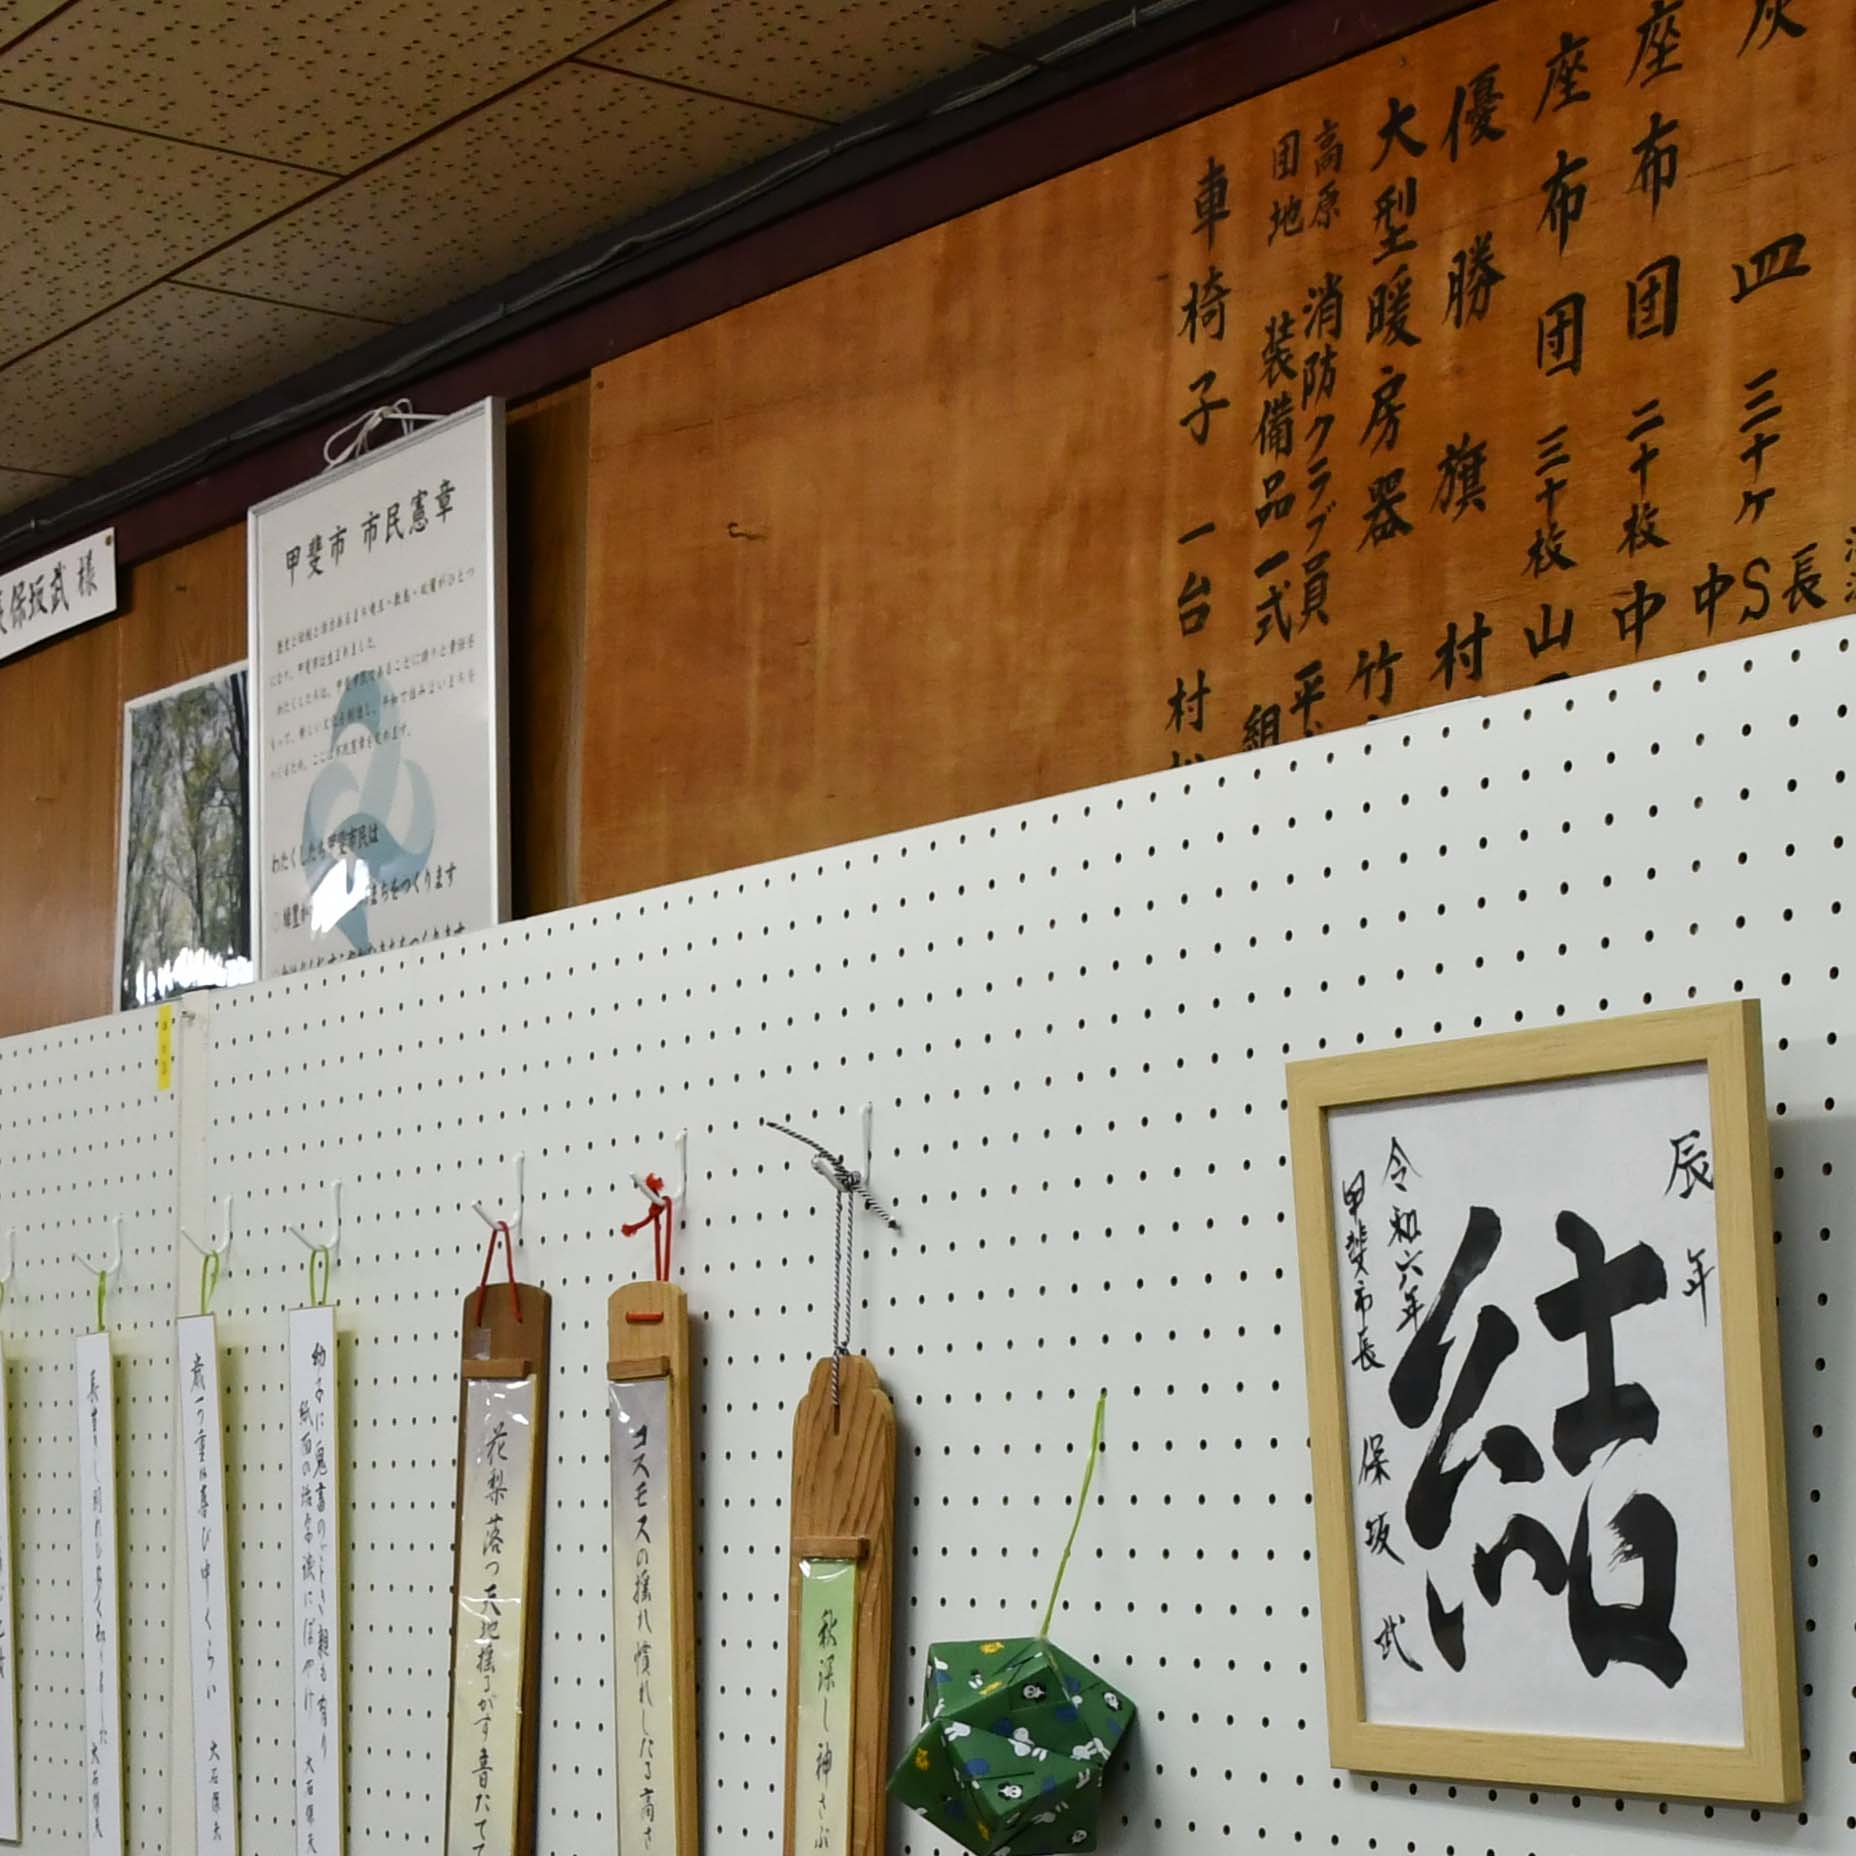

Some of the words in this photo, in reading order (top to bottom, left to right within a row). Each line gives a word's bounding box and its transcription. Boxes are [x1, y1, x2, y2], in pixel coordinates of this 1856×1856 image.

[1309, 119, 1344, 231] 高原
[1534, 32, 1592, 376] 座布団
[1624, 0, 1685, 341] 座布団
[1177, 157, 1231, 447] 車椅子
[1356, 97, 1427, 552] 大型暖房器
[1430, 63, 1506, 522] 優勝旗
[284, 525, 348, 587] 甲斐市
[361, 478, 456, 555] 市民憲章
[1177, 522, 1216, 637] 一台
[1250, 310, 1301, 646] 装備品一式
[1522, 426, 1577, 578] 三十枚
[1616, 400, 1670, 558] 二十枚
[1341, 1169, 1387, 1374] 甲斐市長
[1381, 1136, 1428, 1335] 令和六年
[1665, 1129, 1717, 1327] 辰年
[1357, 1433, 1425, 1673] 保坂武
[1387, 1204, 1688, 1690] 結
